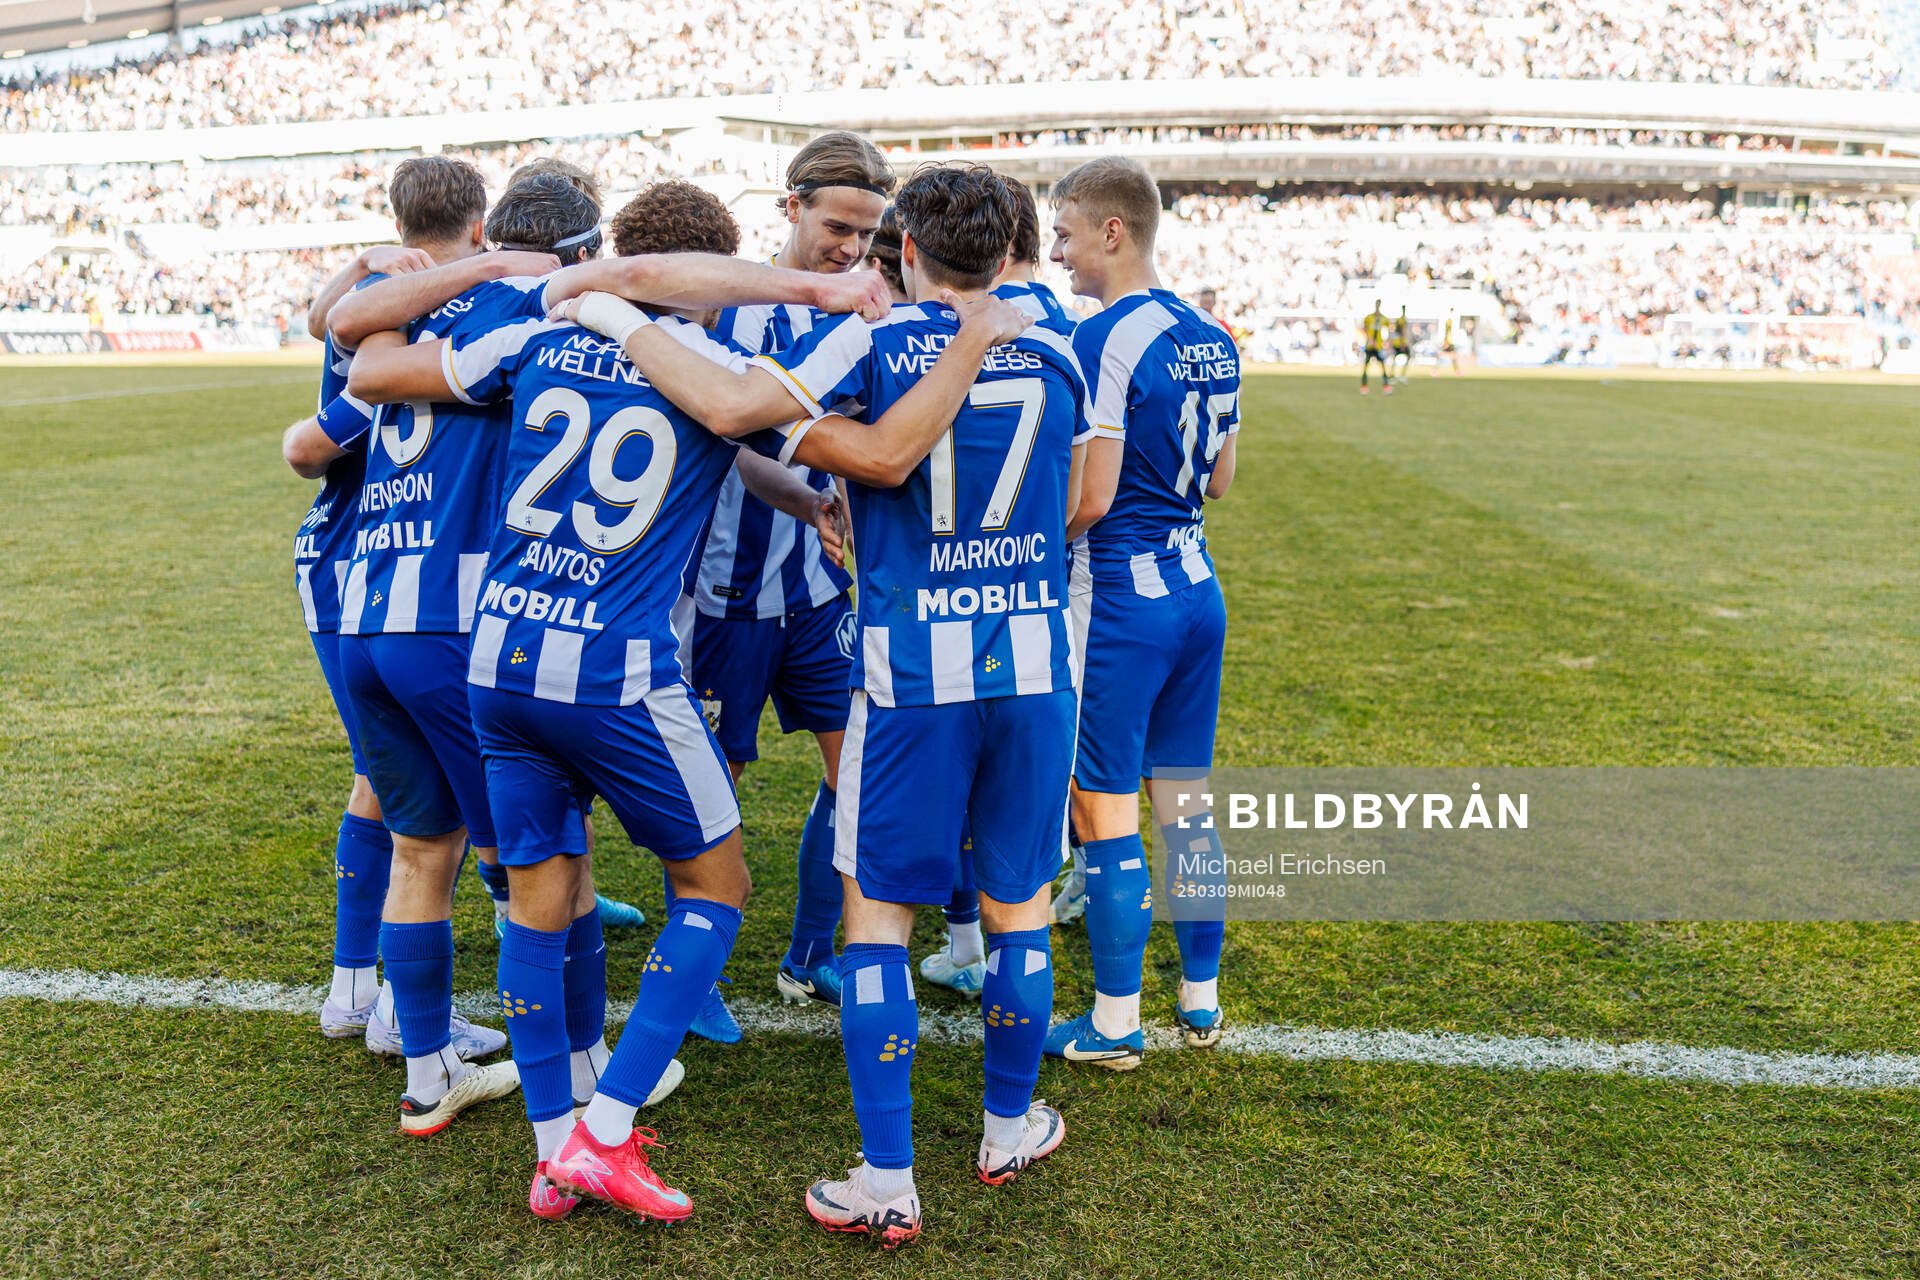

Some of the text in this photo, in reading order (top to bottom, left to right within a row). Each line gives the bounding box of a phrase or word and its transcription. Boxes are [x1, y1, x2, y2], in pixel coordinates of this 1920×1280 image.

[505, 387, 677, 555] 29
[930, 378, 1047, 535] 17
[353, 520, 435, 561] MOBILL
[930, 532, 1046, 573] MARKOVIC
[478, 580, 604, 631] MOBILL
[917, 580, 1059, 621] MOBILL
